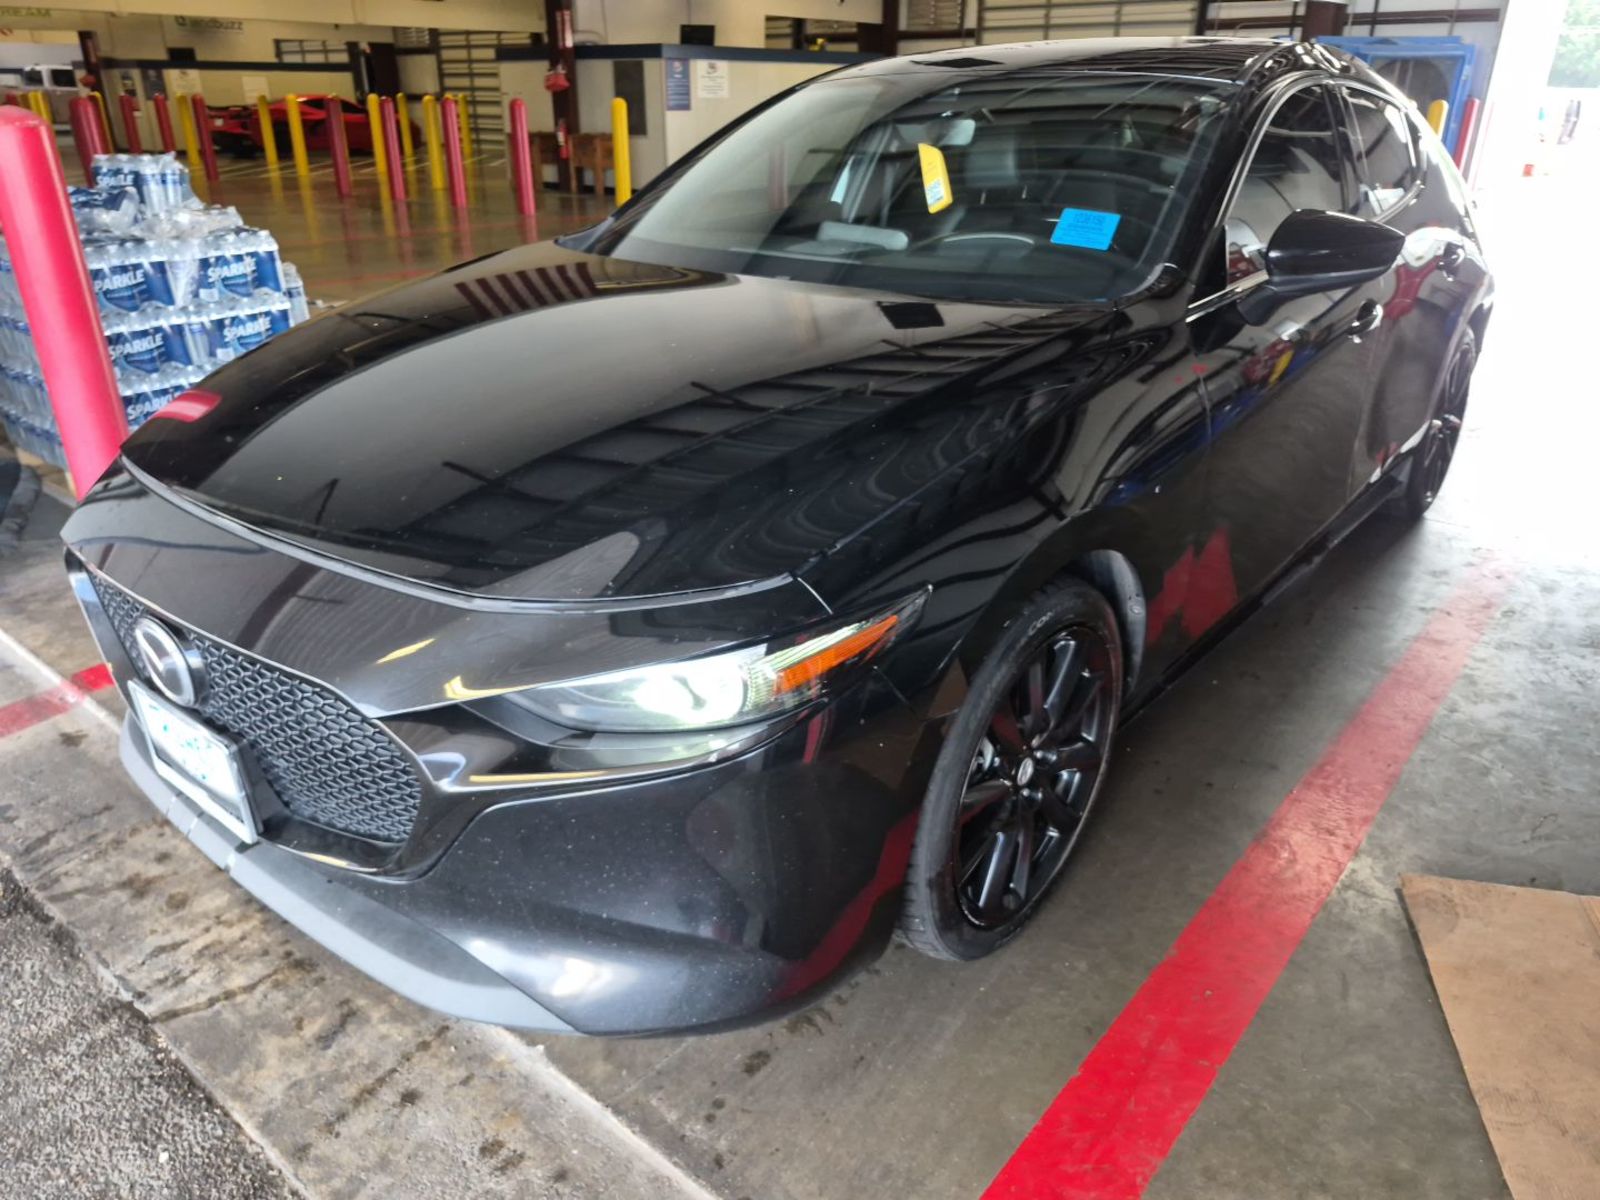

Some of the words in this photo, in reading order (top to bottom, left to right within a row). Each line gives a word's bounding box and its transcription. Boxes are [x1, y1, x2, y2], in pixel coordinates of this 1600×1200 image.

[93, 269, 146, 293] PARKLE
[109, 333, 164, 360] SPARKLE
[127, 391, 181, 420] SPARK
